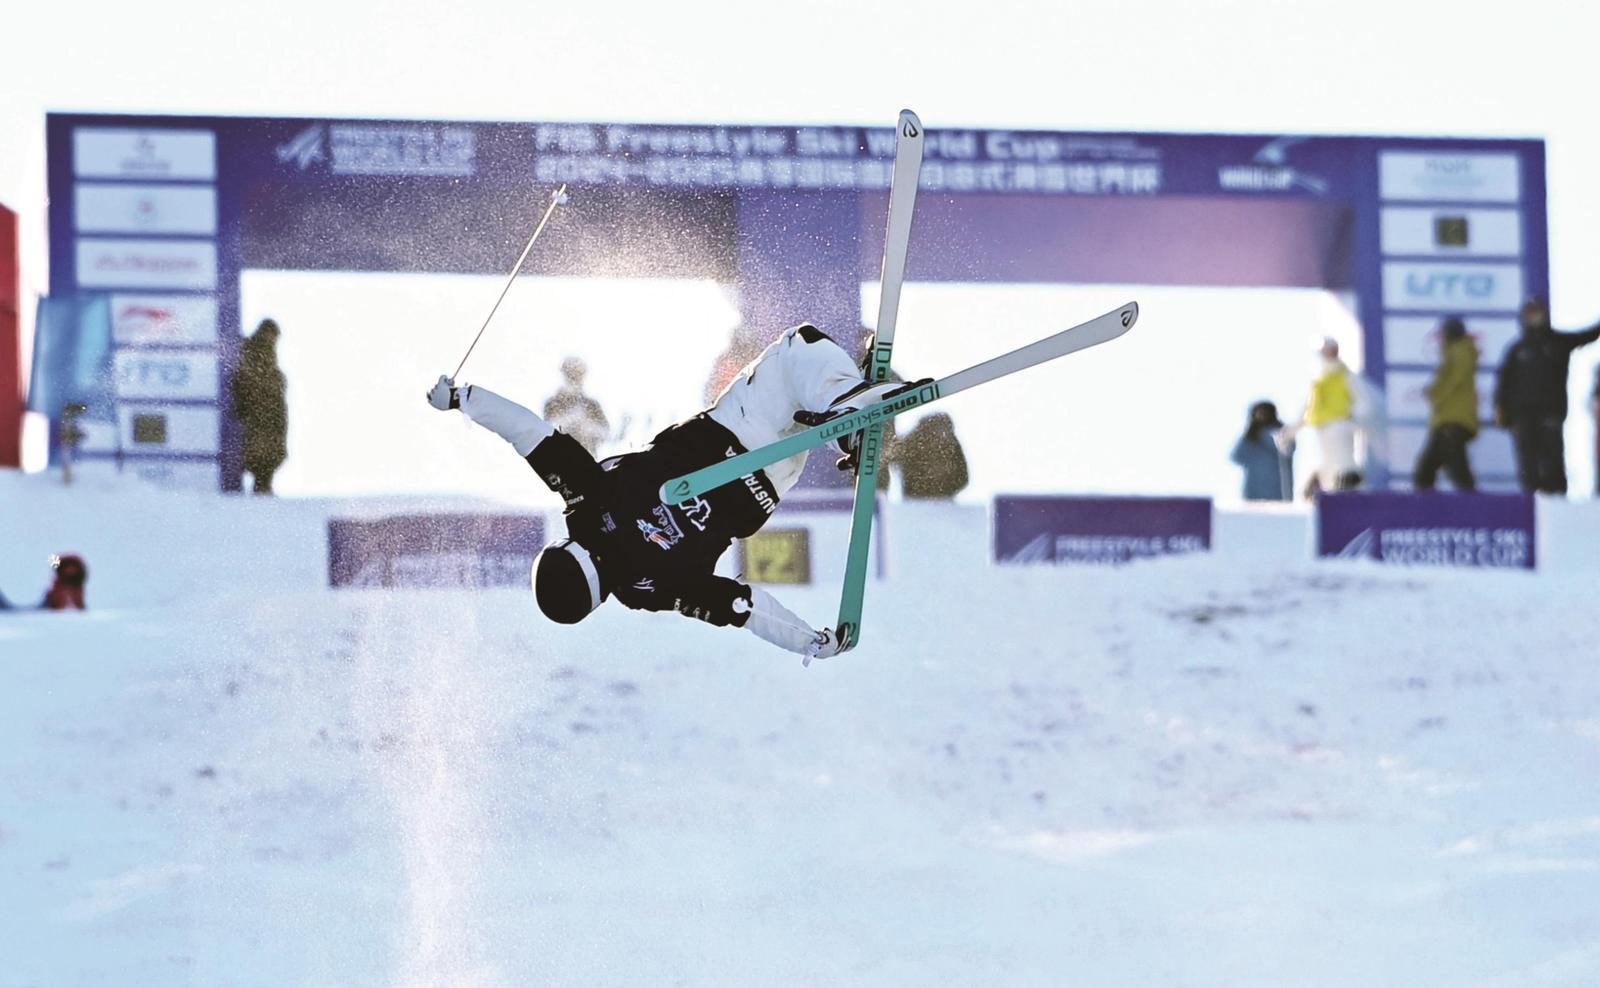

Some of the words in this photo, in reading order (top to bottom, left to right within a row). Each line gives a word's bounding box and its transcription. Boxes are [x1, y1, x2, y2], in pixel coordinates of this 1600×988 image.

[985, 132, 1060, 162] Cup
[725, 445, 776, 514] AUSTRA
[1381, 528, 1488, 545] FREESTYLE
[1382, 545, 1473, 565] WORLD
